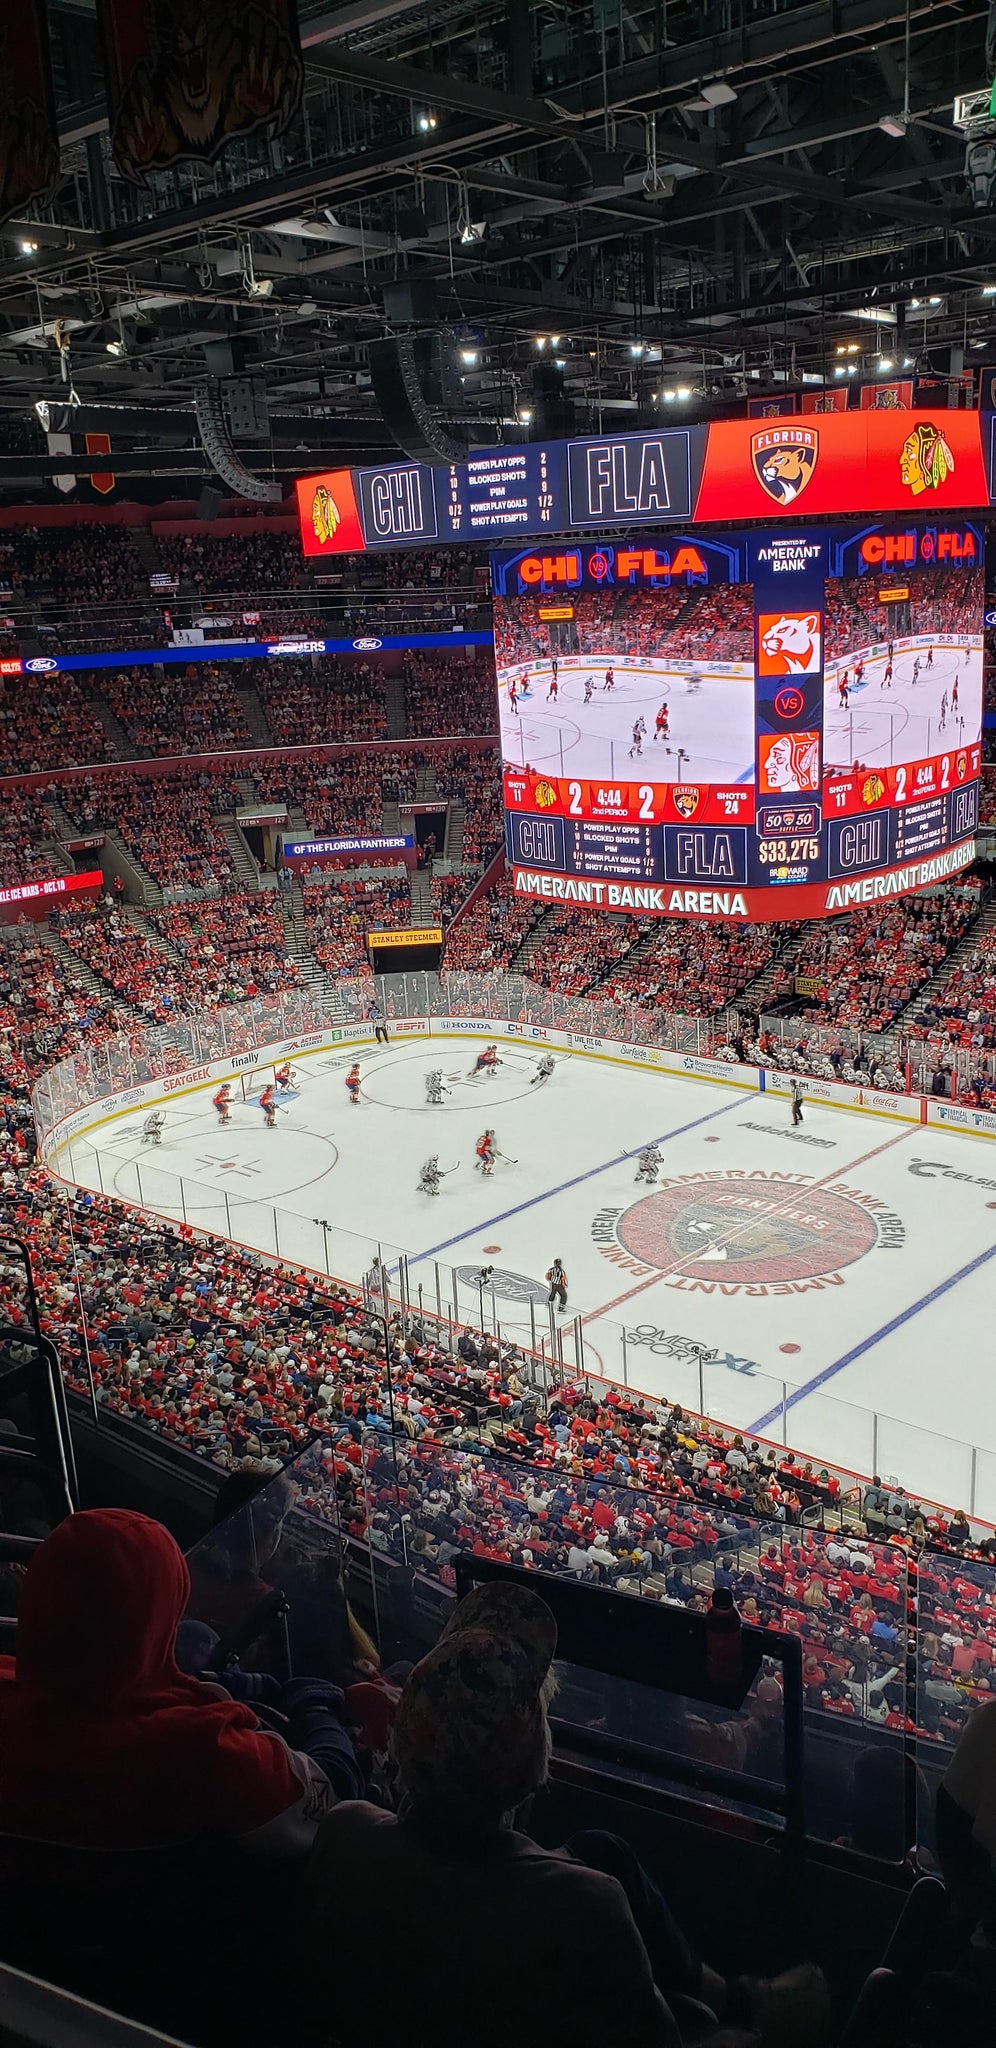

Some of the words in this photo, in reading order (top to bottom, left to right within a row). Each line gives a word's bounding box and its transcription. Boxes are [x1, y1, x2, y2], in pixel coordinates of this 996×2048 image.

[757, 430, 813, 449] FLORIDA
[468, 461, 490, 472] POWER
[490, 459, 507, 470] PLAY
[508, 457, 526, 467] OPPS
[541, 453, 546, 464] 2
[450, 477, 458, 489] 10
[469, 474, 500, 485] BLOCKED
[501, 471, 527, 481] SHOTS
[541, 467, 547, 478] 9
[586, 442, 671, 516] FLA
[489, 487, 506, 497] PIM
[542, 481, 547, 493] 9
[371, 470, 424, 535] CHI
[449, 504, 462, 516] 0/2
[470, 503, 491, 513] POWER
[491, 501, 507, 511] PLAY
[507, 499, 528, 509] GOALS
[452, 518, 460, 530] 27
[471, 516, 490, 526] SHOT
[490, 513, 528, 525] ATTEMPTS
[541, 510, 550, 521] 41
[758, 545, 821, 560] AMERANT
[862, 535, 914, 563] CHI
[937, 533, 975, 558] FLA
[520, 556, 578, 583] CHI
[592, 562, 604, 571] VS
[617, 548, 706, 578] FLA
[773, 558, 806, 572] BANK
[781, 697, 798, 709] VS
[917, 766, 933, 785] 4:44
[941, 756, 950, 789] 2
[508, 781, 526, 789] SHOTS
[828, 784, 852, 794] SHOTS
[895, 768, 907, 801] 2
[514, 789, 521, 801] 11
[569, 782, 582, 814] 2
[597, 789, 621, 806] 4:44
[638, 785, 654, 819] 2
[835, 793, 845, 807] 11
[604, 808, 628, 816] PERIOD
[725, 801, 739, 814] 24
[956, 789, 974, 833] FLA
[766, 815, 781, 827] 50
[796, 813, 812, 825] 50
[905, 815, 926, 825] BLOCKED
[583, 824, 604, 832] POWER
[605, 825, 621, 833] PLAY
[622, 826, 639, 834] OPPS
[645, 828, 650, 836] 2
[294, 846, 307, 854] OF
[307, 844, 324, 853] THE
[324, 841, 360, 852] FLORIDA
[361, 838, 406, 849] PANTHERS
[519, 820, 555, 862] CHI
[584, 834, 614, 843] BLOCKED
[615, 836, 640, 844] SHOTS
[839, 819, 880, 867] CHI
[605, 845, 618, 853] PIM
[677, 833, 733, 876] FLA
[759, 838, 818, 864] $33,275
[585, 853, 604, 862] POWER
[604, 855, 620, 863] PLAY
[620, 856, 640, 865] GOALS
[585, 863, 603, 871] SHOT
[603, 864, 641, 875] ATTEMPTS
[825, 868, 918, 909] AMERANT
[918, 857, 949, 885] BANK
[950, 840, 976, 871] ARENA
[11, 888, 21, 900] ICE
[21, 885, 40, 898] WARS
[515, 872, 604, 904] AMERANT
[608, 885, 665, 911] BANK
[669, 890, 749, 916] ARENA
[373, 936, 404, 944] STANLEY
[405, 933, 438, 942] STEEMER
[344, 1029, 367, 1038] Baptist
[396, 1022, 425, 1031] ESPN
[451, 1022, 492, 1030] HONDA
[508, 1023, 523, 1033] CH
[532, 1028, 547, 1037] CH
[301, 1035, 323, 1043] ACTION
[620, 1044, 647, 1057] Surfside
[231, 1052, 259, 1068] finally
[695, 1060, 716, 1069] Broward
[163, 1066, 212, 1092] SEATGEEK
[737, 1121, 837, 1149] AutoNation
[661, 1169, 815, 1188] AMERANT
[827, 1183, 890, 1211] BANK
[876, 1212, 906, 1249] ARENA
[715, 1195, 830, 1231] PANTHERS
[592, 1207, 624, 1243] ARENA
[597, 1246, 654, 1277] BANK
[665, 1273, 845, 1296] AMERANT
[620, 1332, 700, 1365] SPORT
[636, 1325, 719, 1359] OMEGA
[703, 1352, 757, 1377] XL
